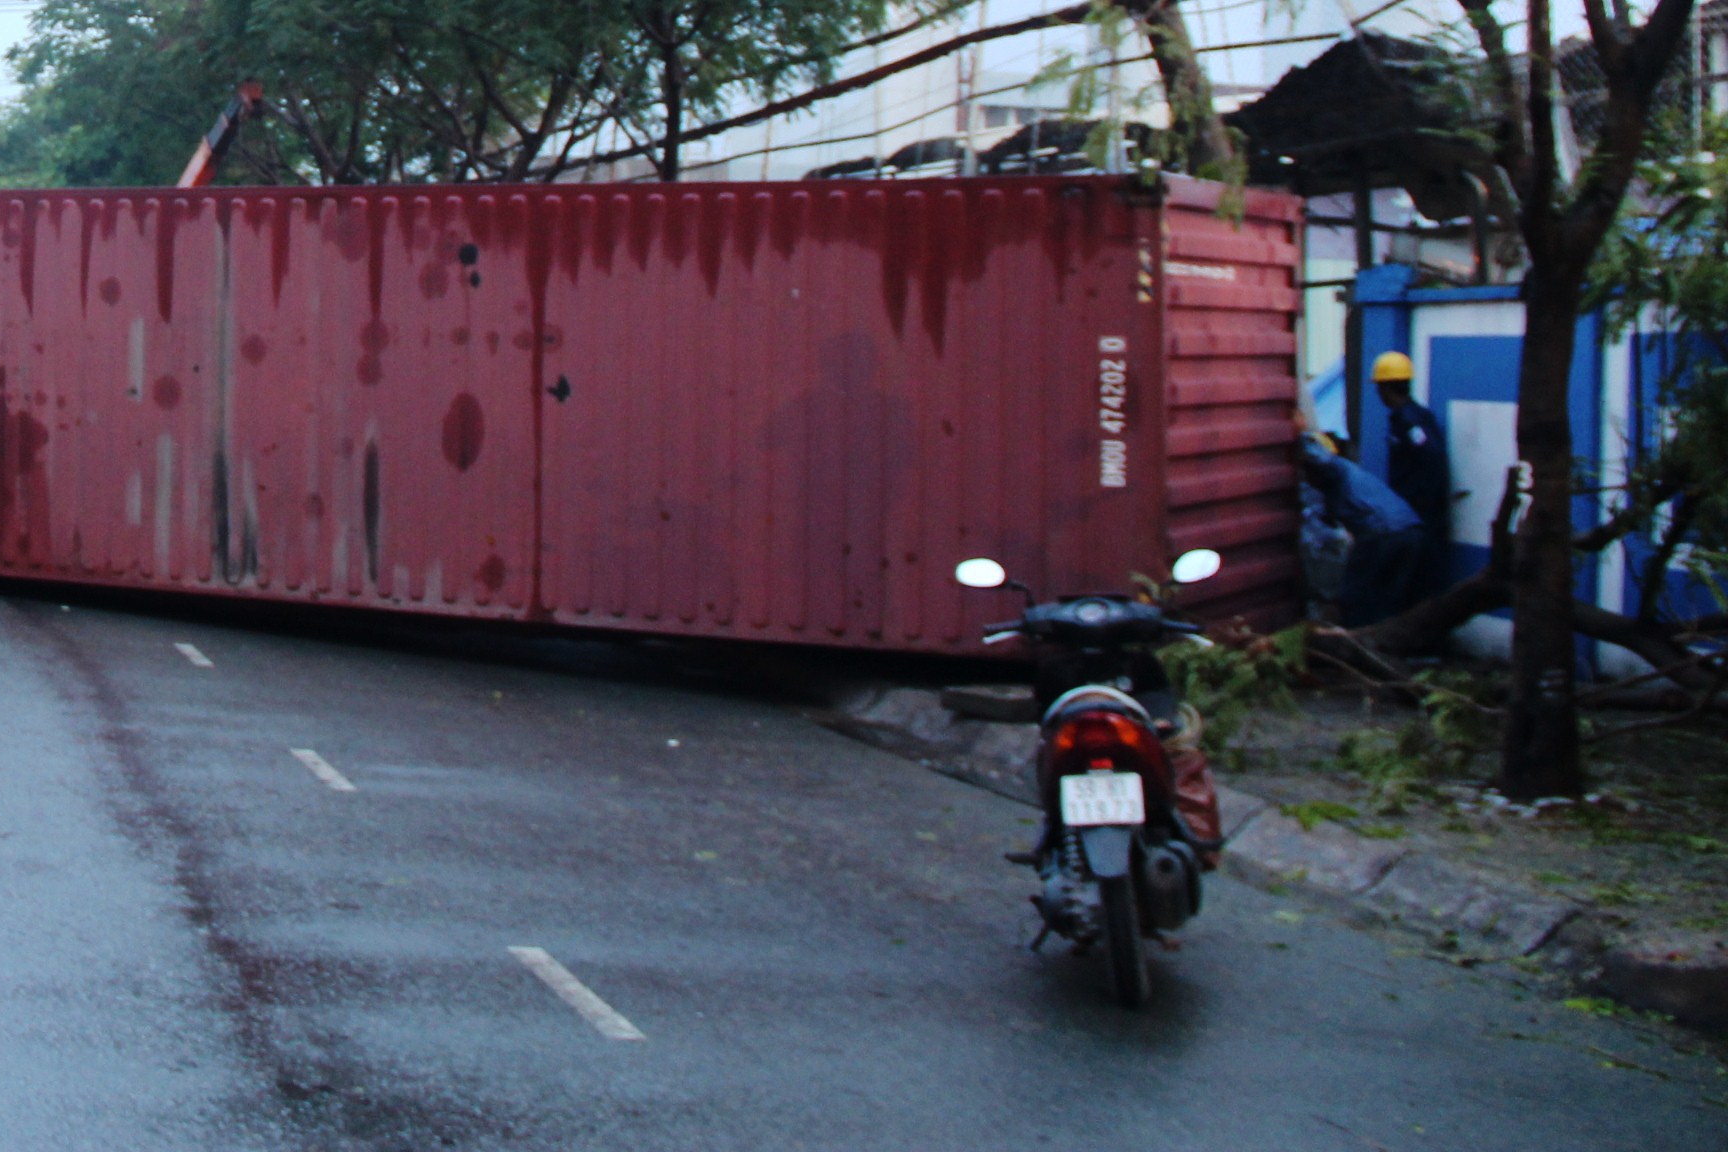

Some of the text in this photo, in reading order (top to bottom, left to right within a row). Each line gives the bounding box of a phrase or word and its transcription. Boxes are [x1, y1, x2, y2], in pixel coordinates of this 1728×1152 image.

[1098, 336, 1127, 488] BMOU 474202 0
